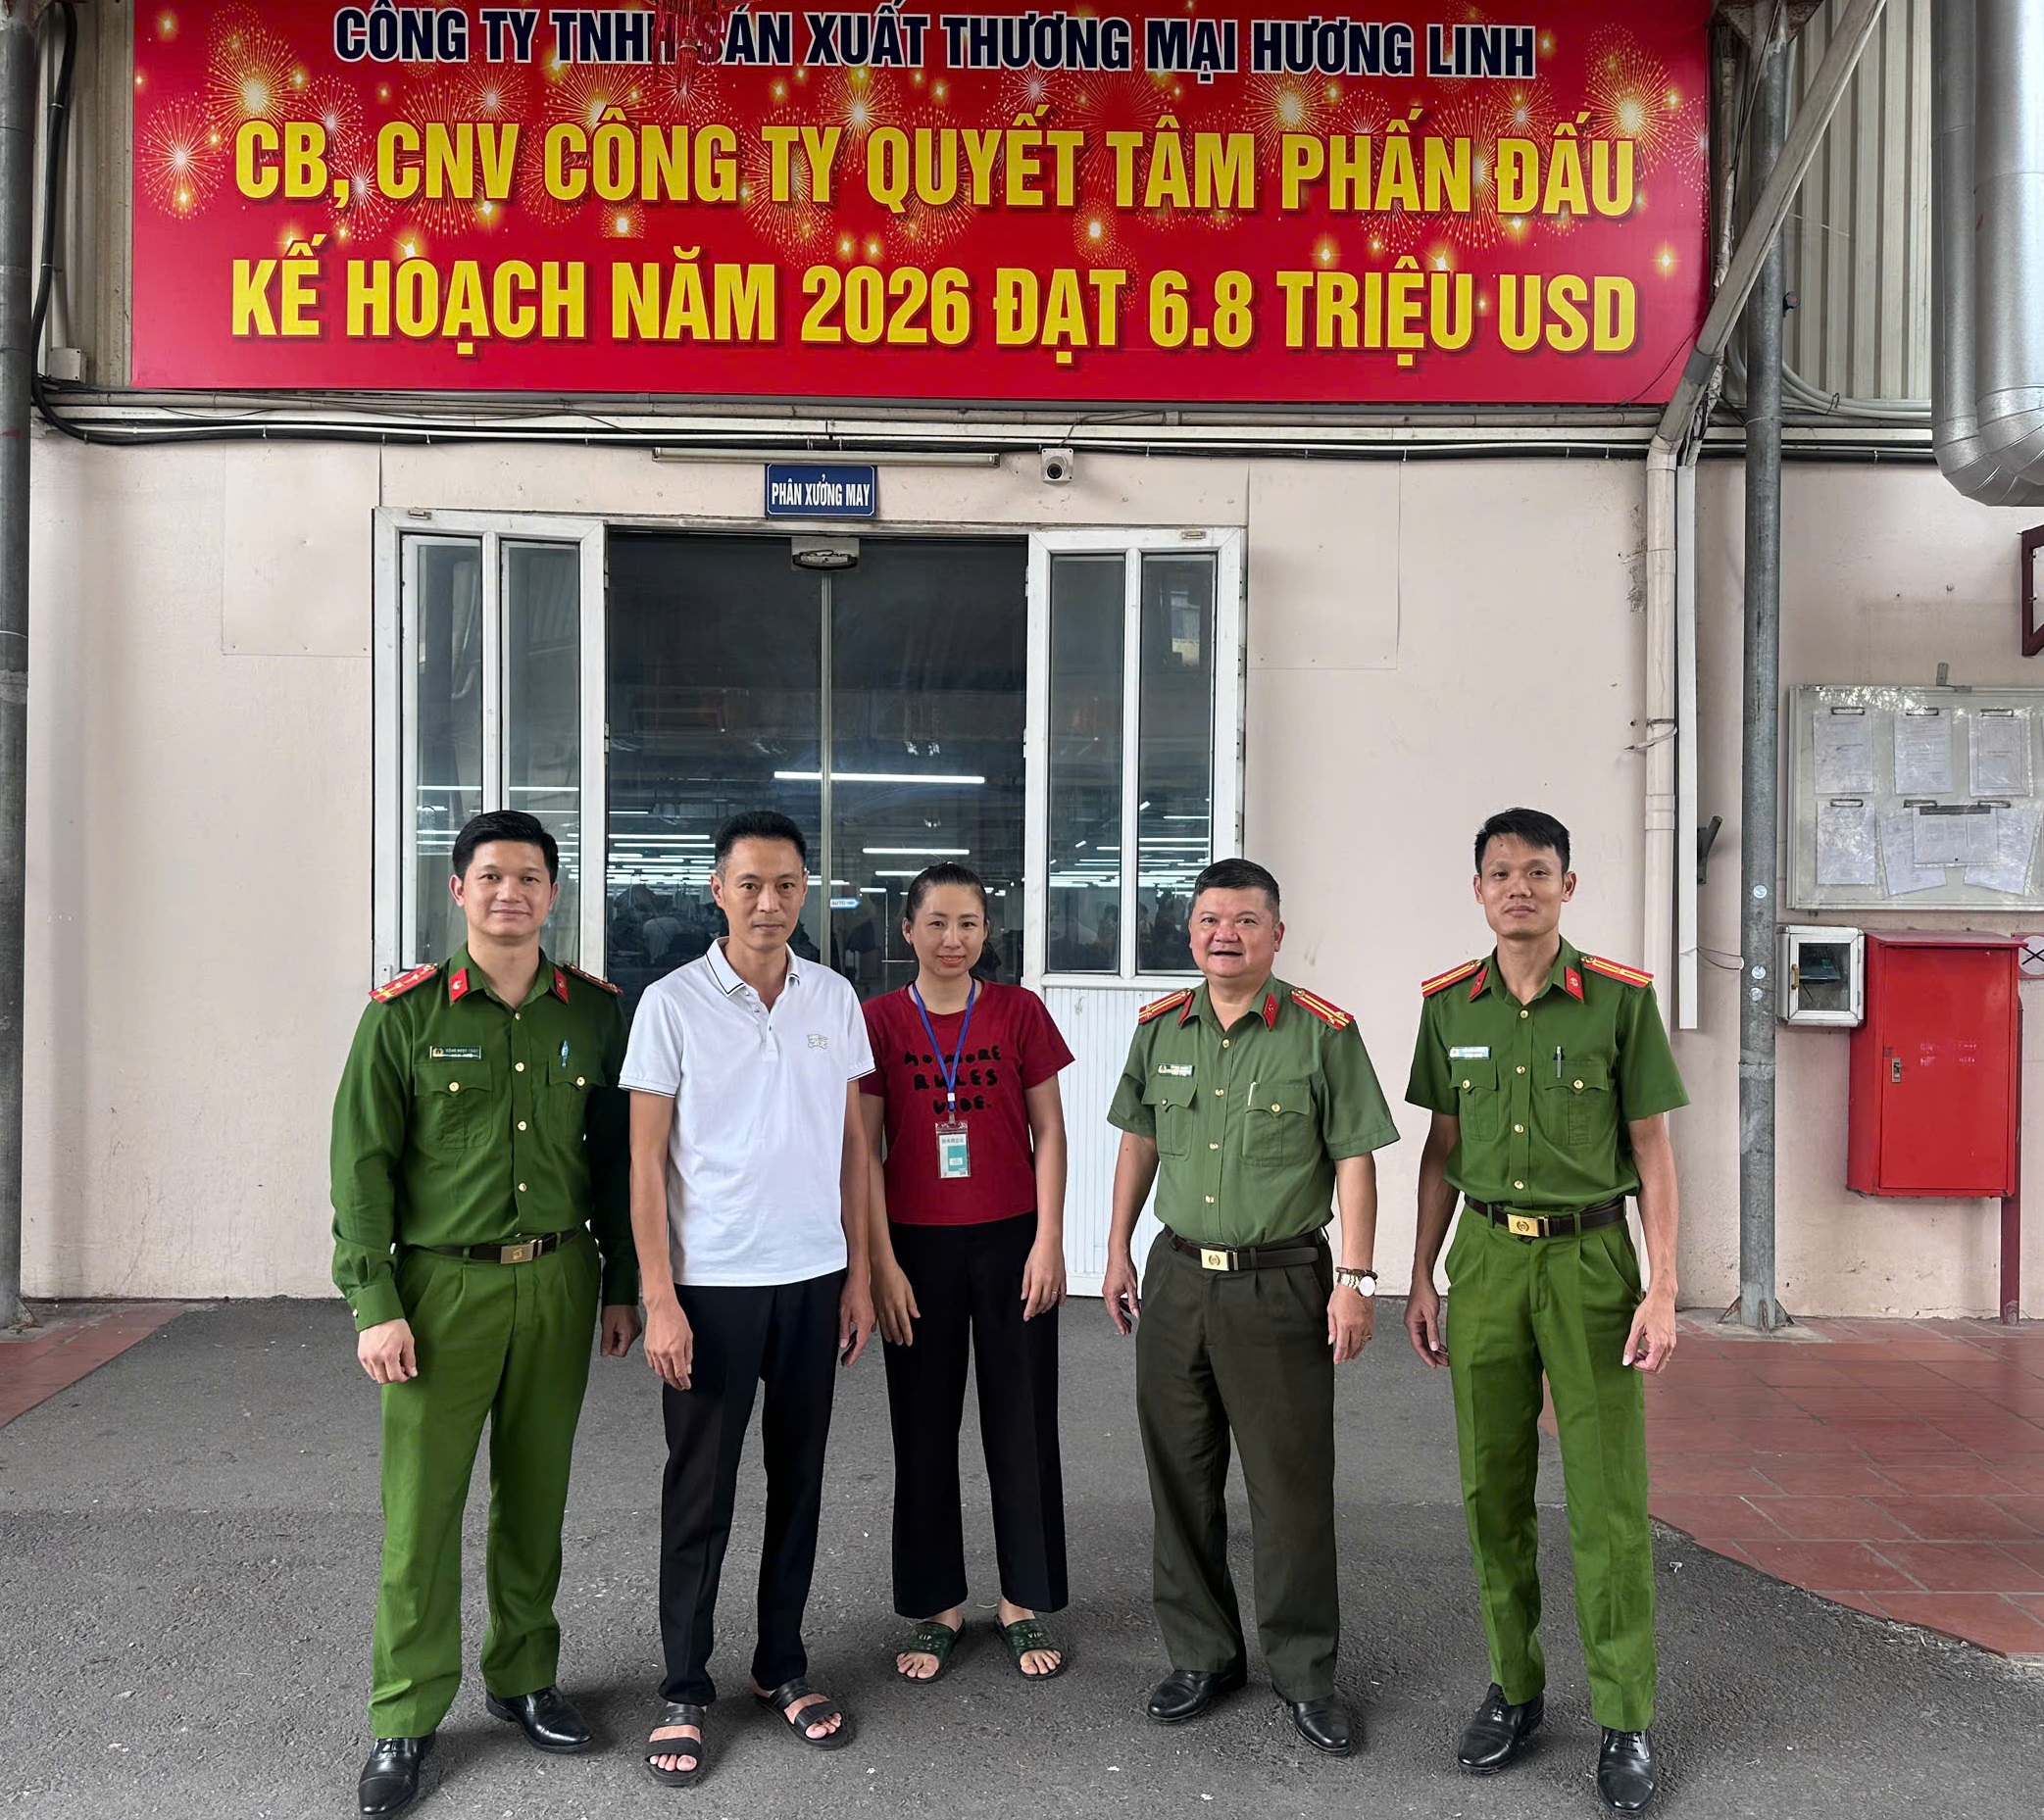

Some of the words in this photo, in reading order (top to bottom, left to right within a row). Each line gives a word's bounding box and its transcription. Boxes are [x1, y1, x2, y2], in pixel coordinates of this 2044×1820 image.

[334, 0, 469, 62] CÔNG
[479, 8, 540, 63] TY
[804, 0, 930, 68] XUẤT
[940, 11, 1131, 72] THƯƠNG
[1145, 18, 1238, 84] MẠI
[1251, 16, 1415, 77] HƯƠNG
[1427, 23, 1536, 79] LINH
[235, 121, 350, 209] CB,
[376, 122, 520, 200] CNV
[544, 107, 738, 202] CÔNG
[761, 125, 838, 203] TY
[867, 104, 1085, 214] QUYẾT
[1106, 115, 1255, 209] TÂM
[1281, 108, 1471, 213] PHẤN
[1495, 111, 1634, 217] ĐẤU
[231, 234, 324, 337] KẾ
[346, 258, 586, 355] HOẠCH
[611, 245, 776, 342] NĂM
[801, 265, 971, 346] 2026
[992, 267, 1127, 365] ĐẠT
[1148, 270, 1254, 348] 6.8
[1276, 255, 1473, 367] TRIỆU
[1498, 273, 1637, 353] USD
[772, 477, 802, 506] PHÂN
[805, 473, 843, 507] XƯỞNG
[845, 483, 871, 507] MAY
